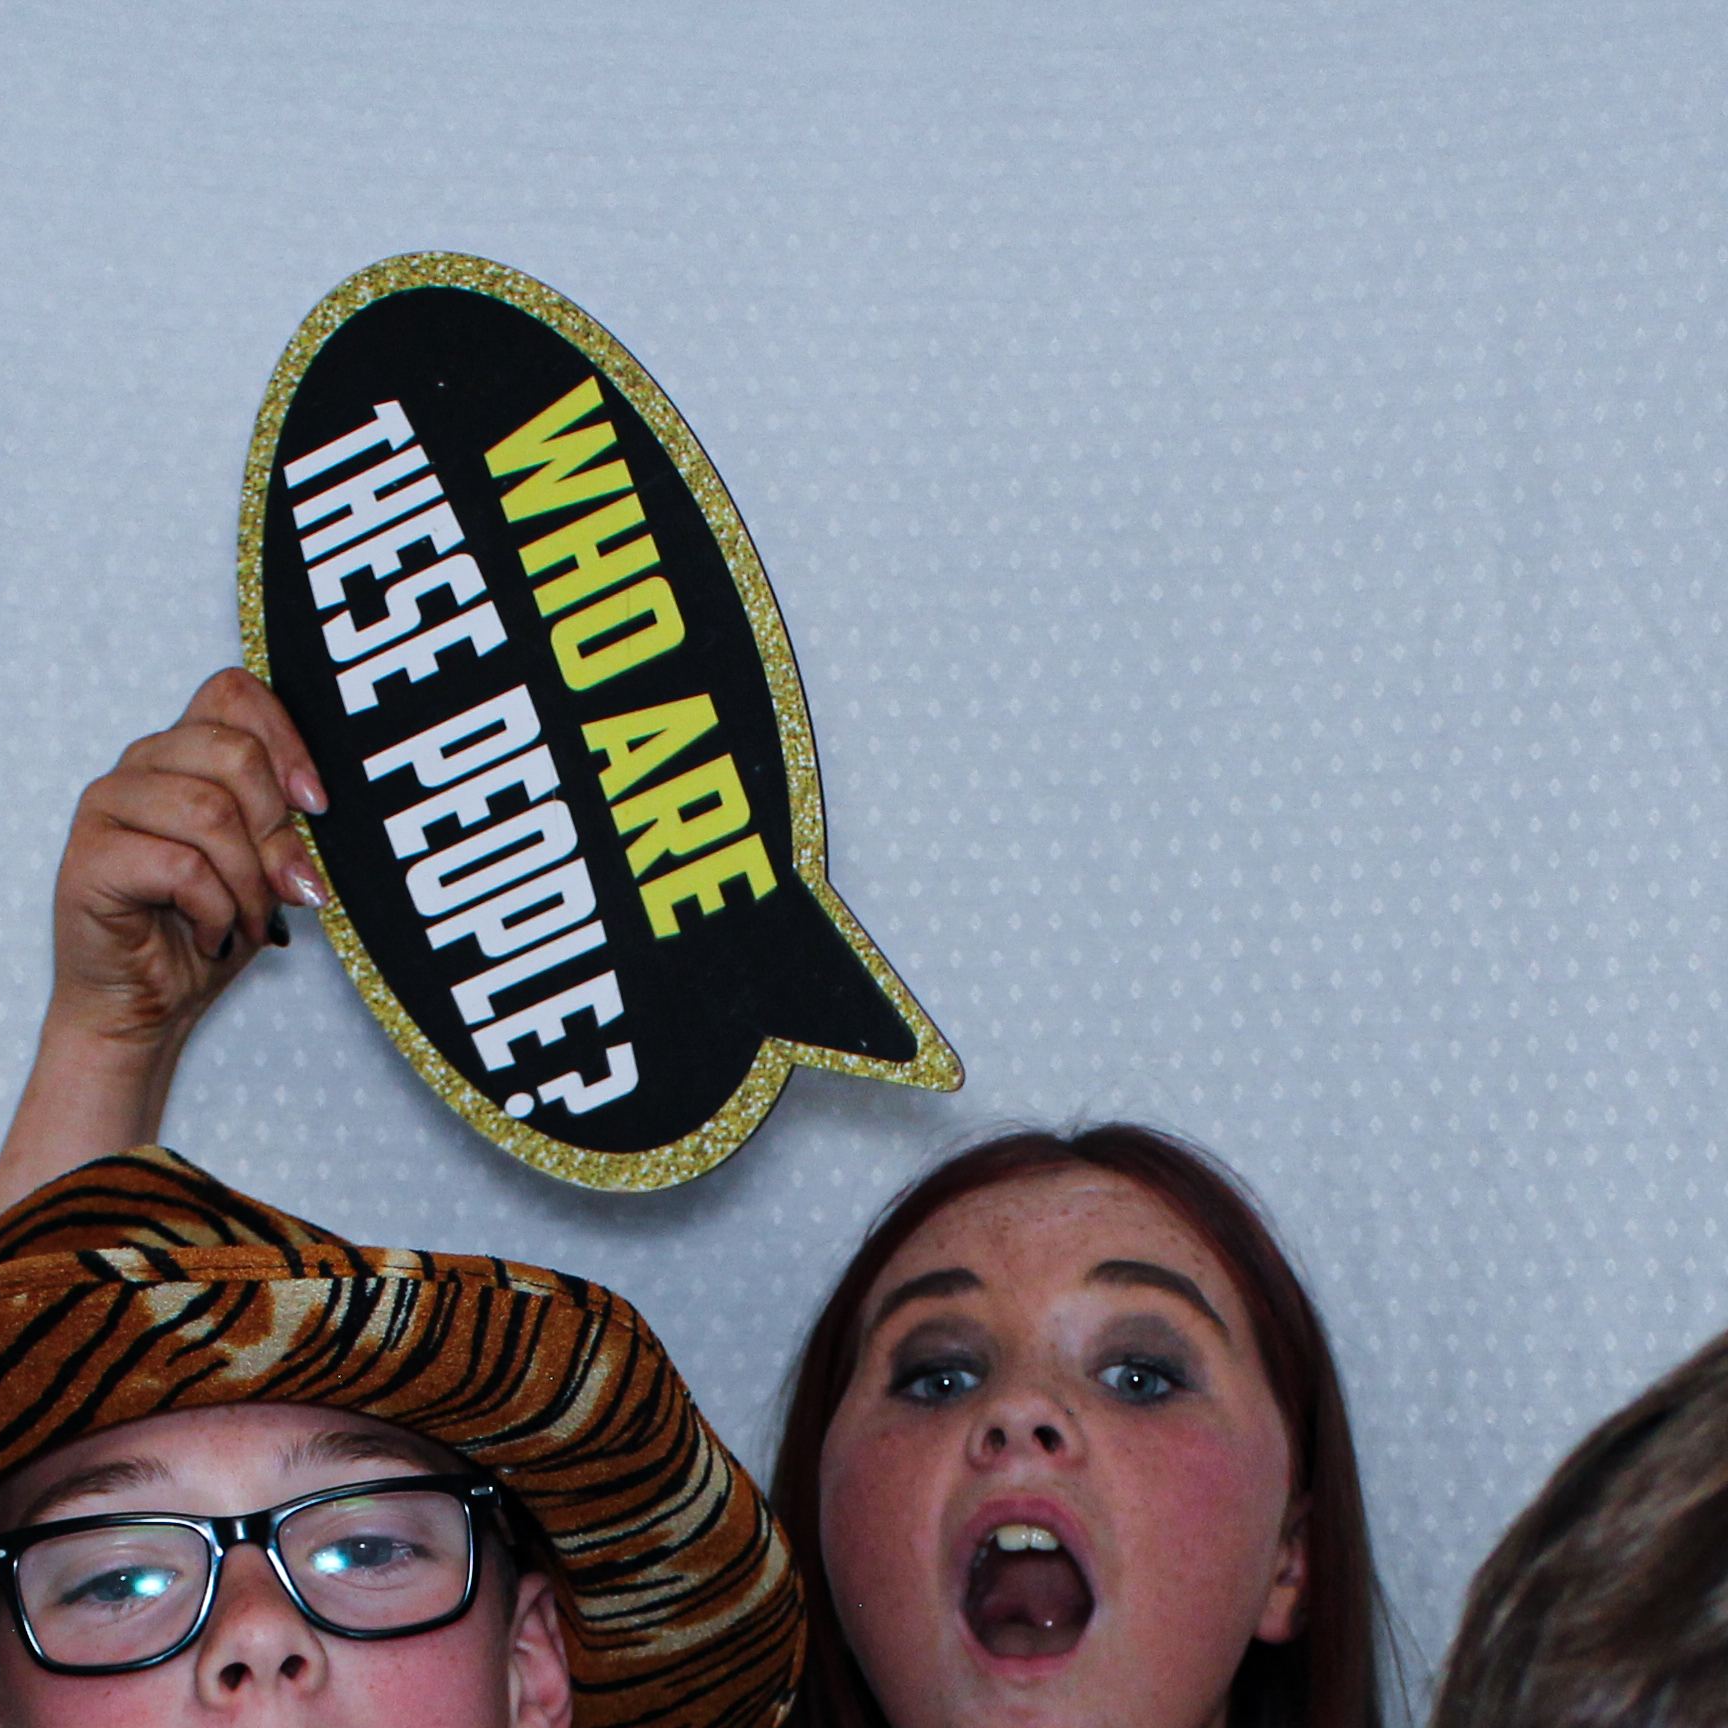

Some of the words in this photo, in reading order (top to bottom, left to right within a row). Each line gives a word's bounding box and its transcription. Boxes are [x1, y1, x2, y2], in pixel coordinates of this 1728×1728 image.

[283, 399, 508, 715] THESE
[484, 375, 686, 692] WHO
[362, 684, 639, 1118] PEOPLE?
[581, 693, 778, 939] ARE
